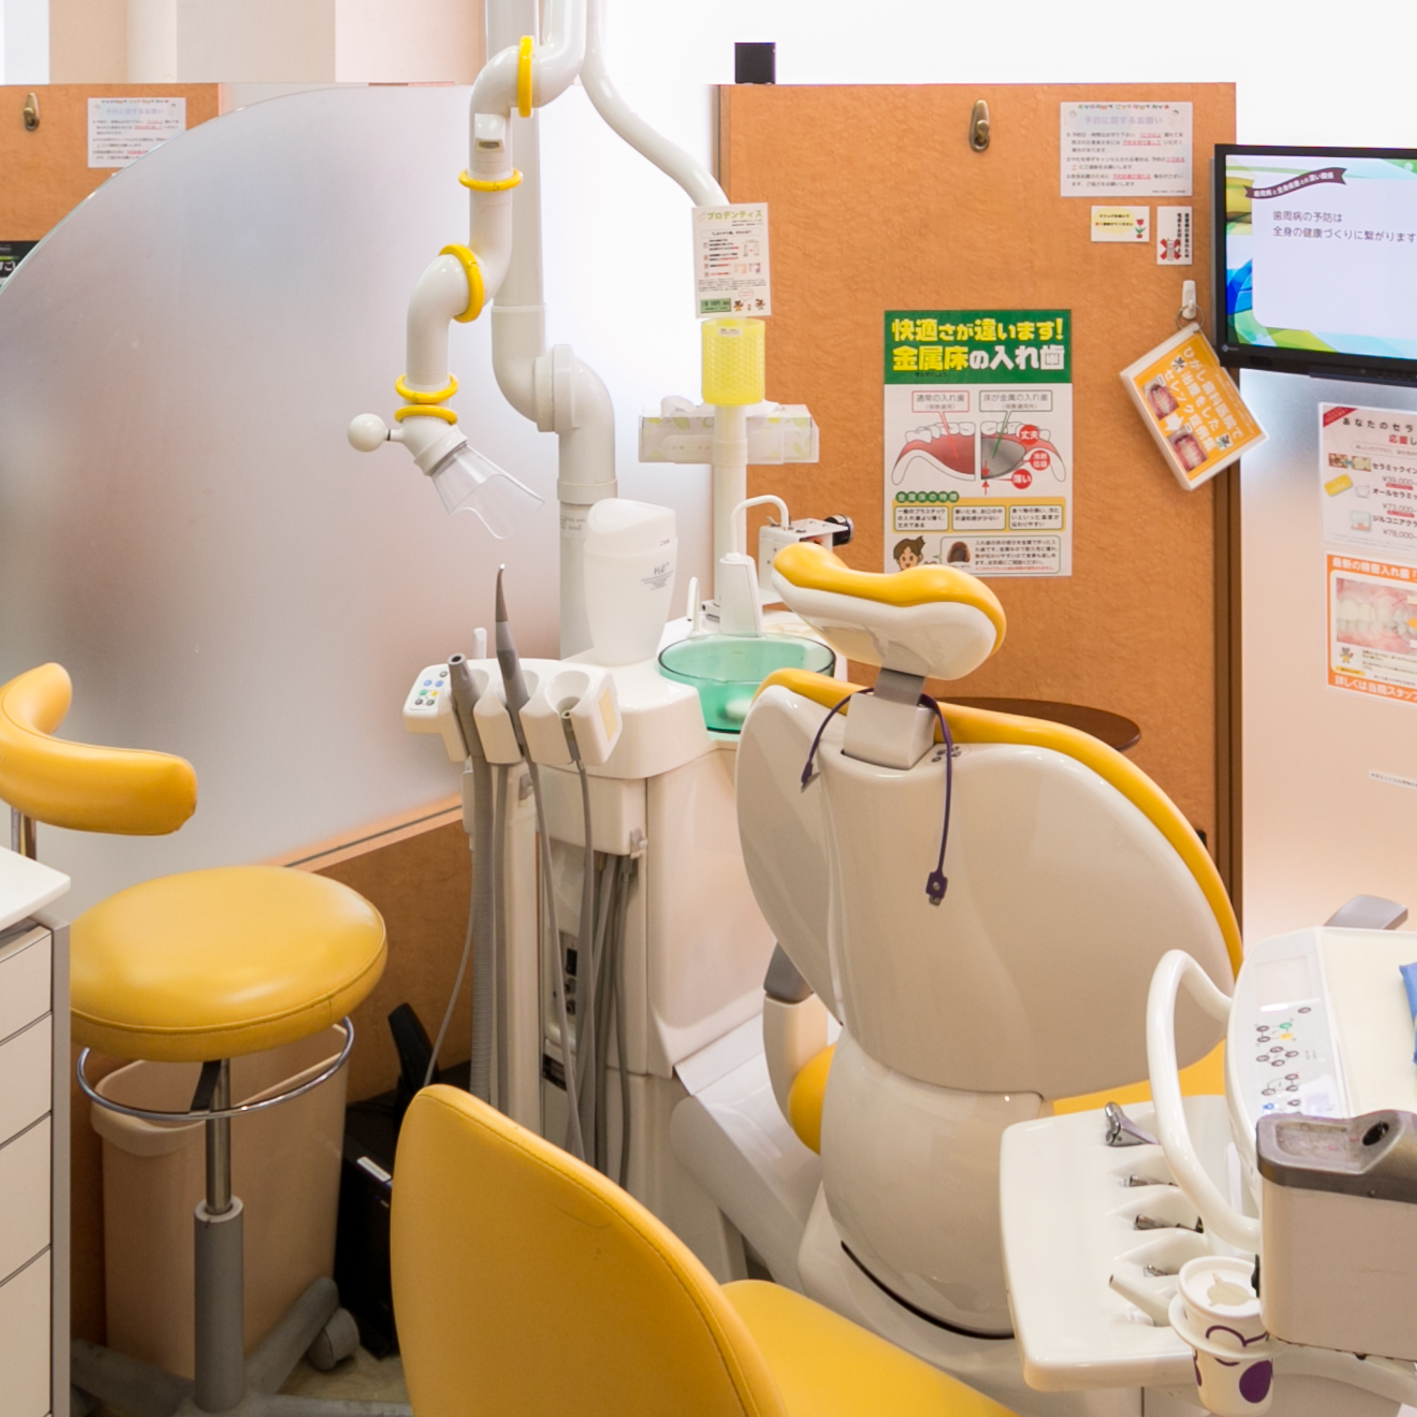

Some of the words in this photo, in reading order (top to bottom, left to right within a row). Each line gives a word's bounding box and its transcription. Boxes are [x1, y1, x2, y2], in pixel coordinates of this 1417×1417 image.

[707, 210, 762, 220] プロデンティス
[1273, 210, 1343, 223] 歯周病の予防は
[892, 318, 1064, 342] 快適さが違います!
[892, 344, 1065, 371] 金属床の入れ歯
[916, 394, 965, 403] 通常の入れ歯
[983, 394, 1048, 403] 床が金属の入れ歯
[1020, 430, 1040, 440] 丈夫
